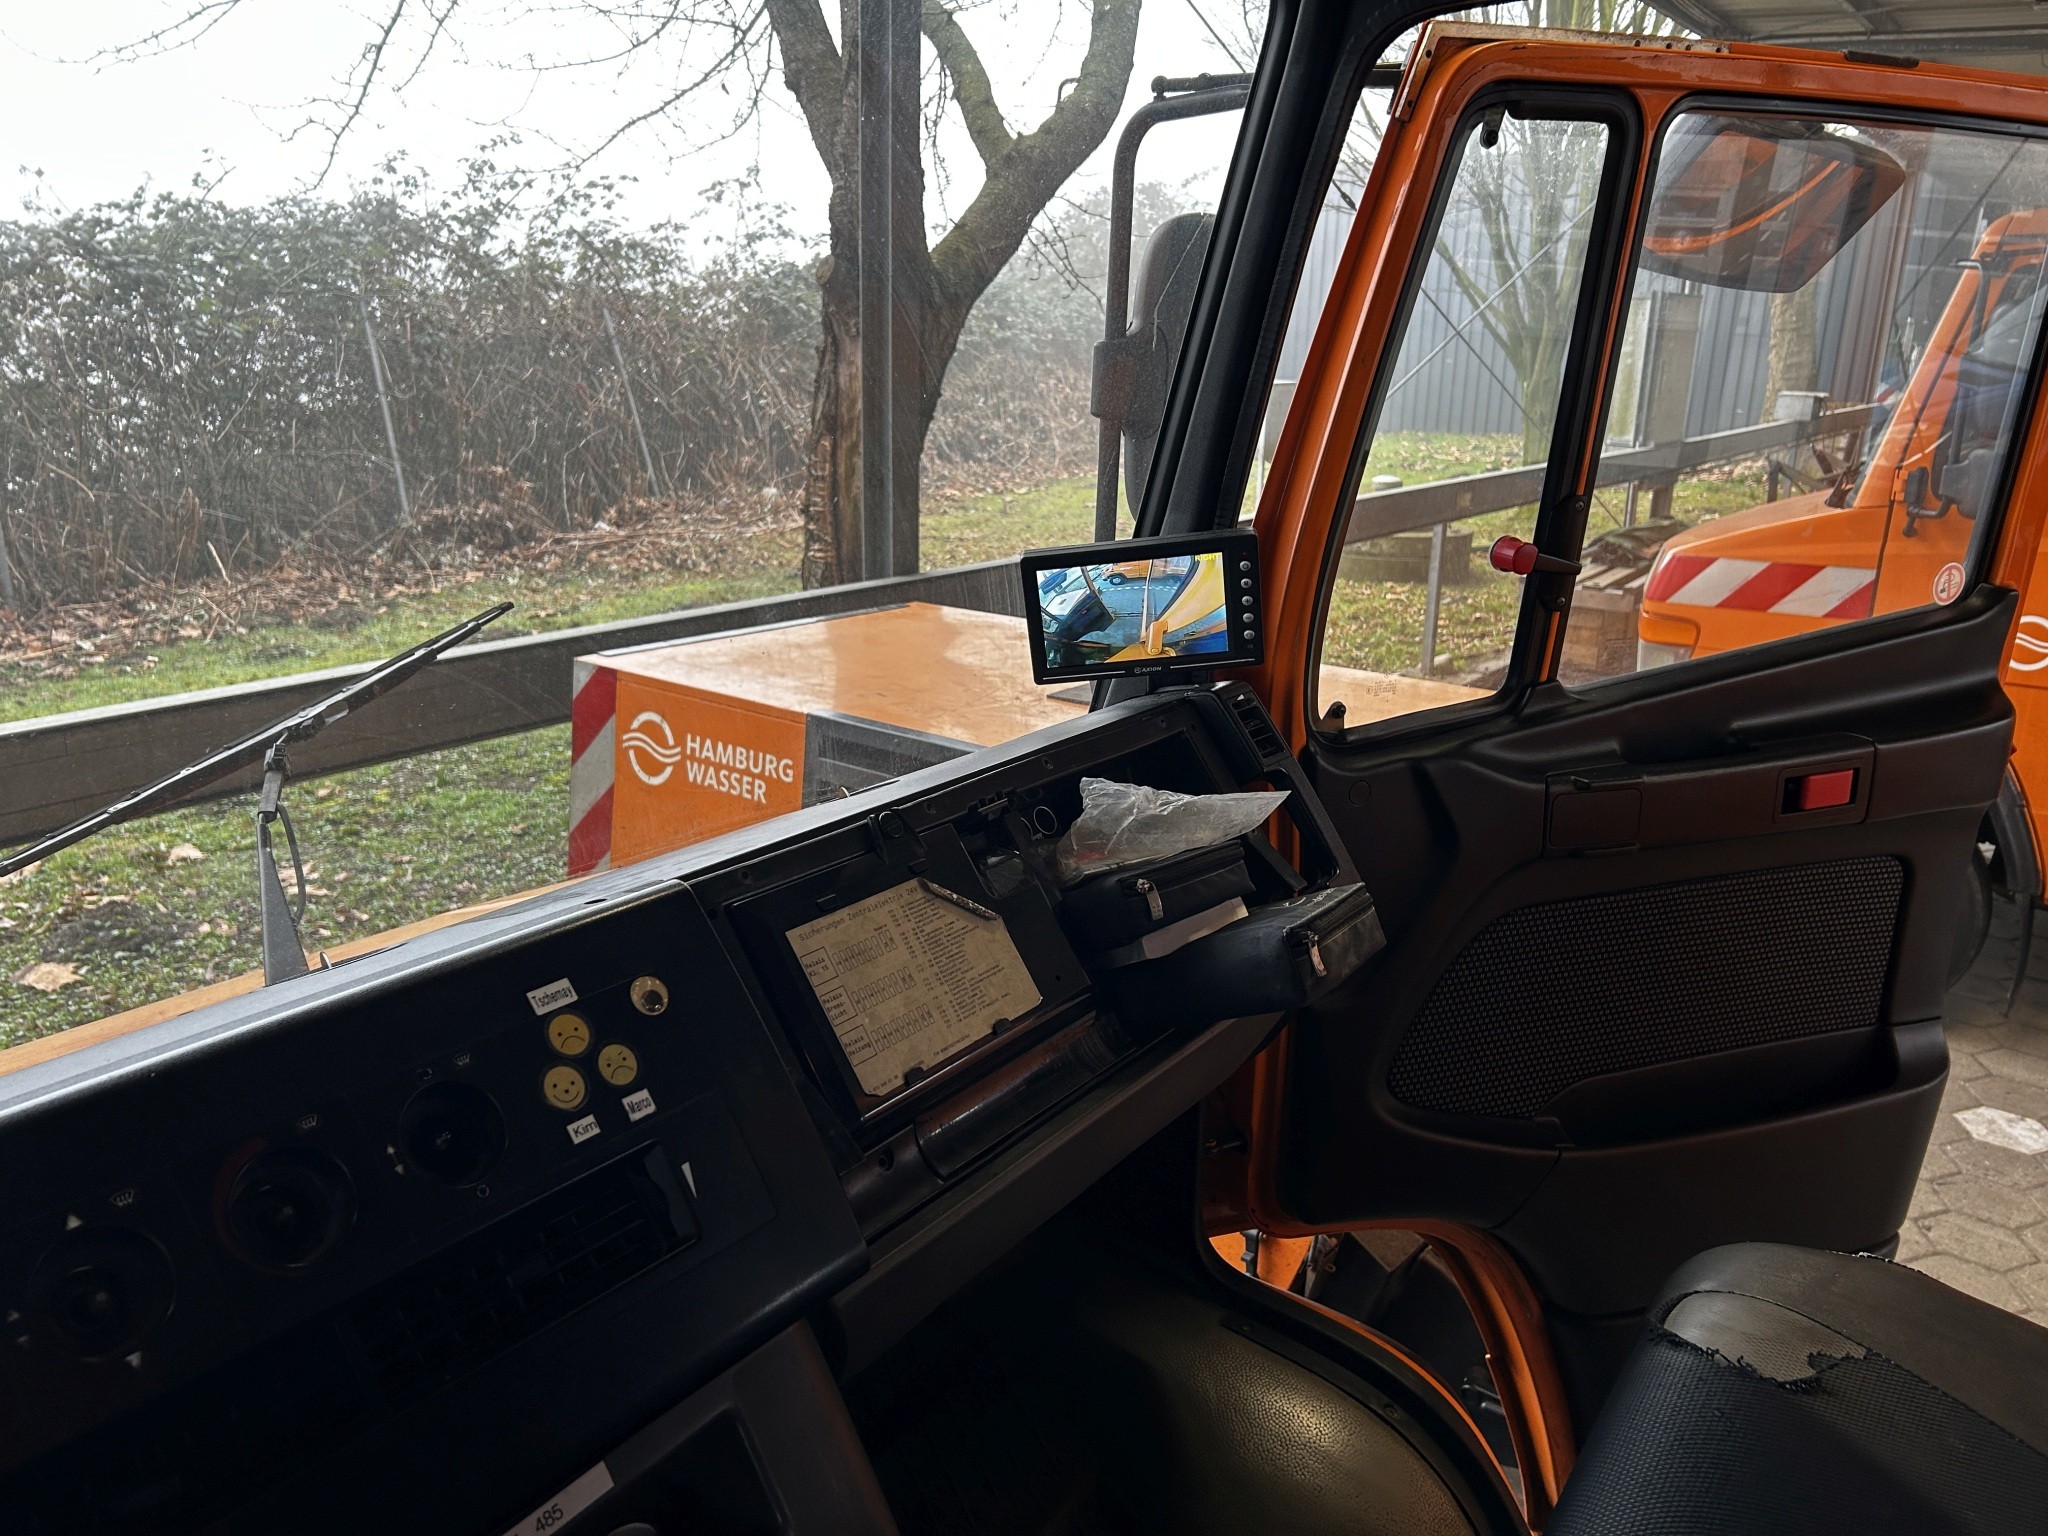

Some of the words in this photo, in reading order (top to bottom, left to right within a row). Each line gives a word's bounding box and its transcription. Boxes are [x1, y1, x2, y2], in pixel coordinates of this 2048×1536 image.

[1194, 553, 1220, 562] RIGHT
[686, 732, 794, 783] HAMBURG
[686, 759, 767, 805] WASSER
[798, 918, 846, 942] Sicherungen
[847, 893, 903, 920] Zentralelektrik
[905, 886, 918, 895] 24V
[804, 957, 825, 969] Relais
[627, 1097, 651, 1114] Marco
[573, 1121, 598, 1137] Kim
[536, 1503, 563, 1531] 485
